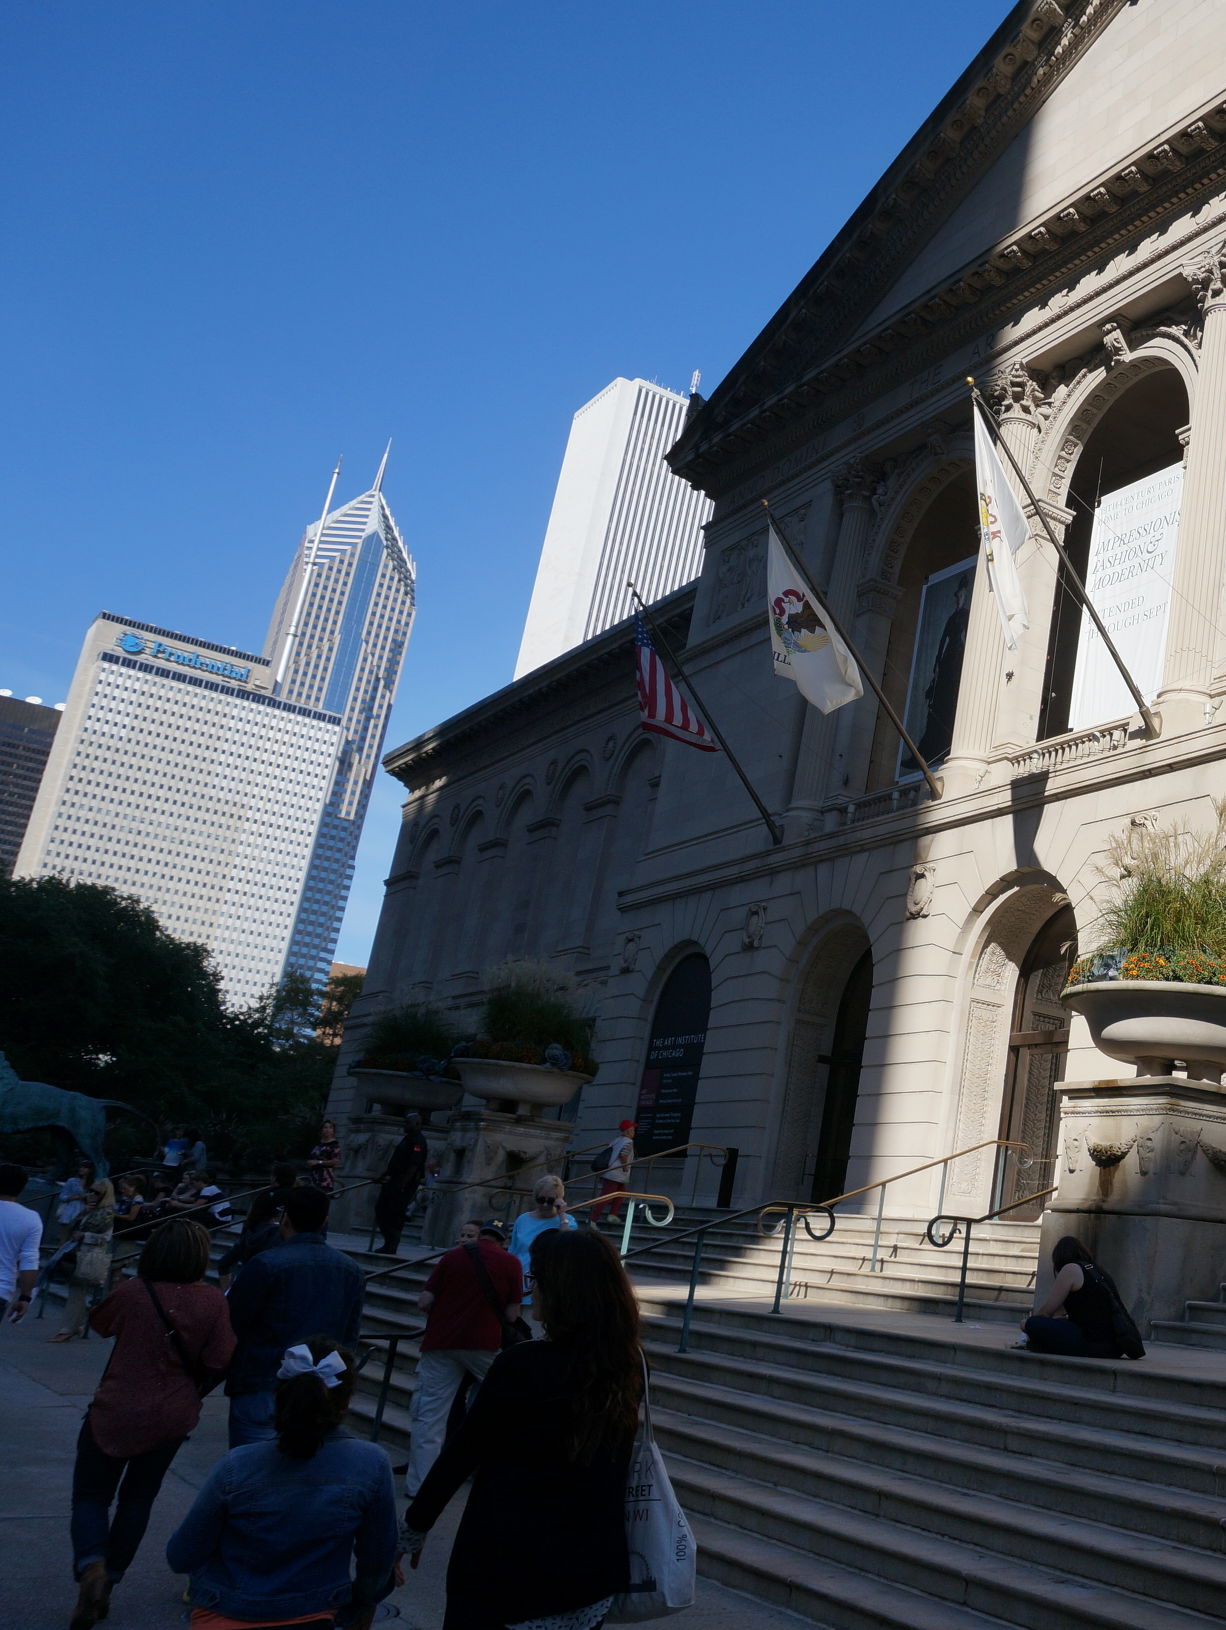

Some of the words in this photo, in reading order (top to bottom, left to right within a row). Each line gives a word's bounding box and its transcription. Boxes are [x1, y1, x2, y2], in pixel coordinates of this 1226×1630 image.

[1135, 488, 1174, 509] CHICAGO
[1094, 510, 1181, 556] IMPRESSIONIS
[1090, 550, 1168, 593] MODERNITY
[1092, 542, 1147, 574] FASHION
[150, 639, 251, 682] Prudential
[650, 1050, 658, 1059] OF
[659, 1047, 684, 1059] CHICAGO
[652, 1037, 664, 1047] THE
[664, 1036, 675, 1047] ART
[674, 1534, 688, 1562] 100%
